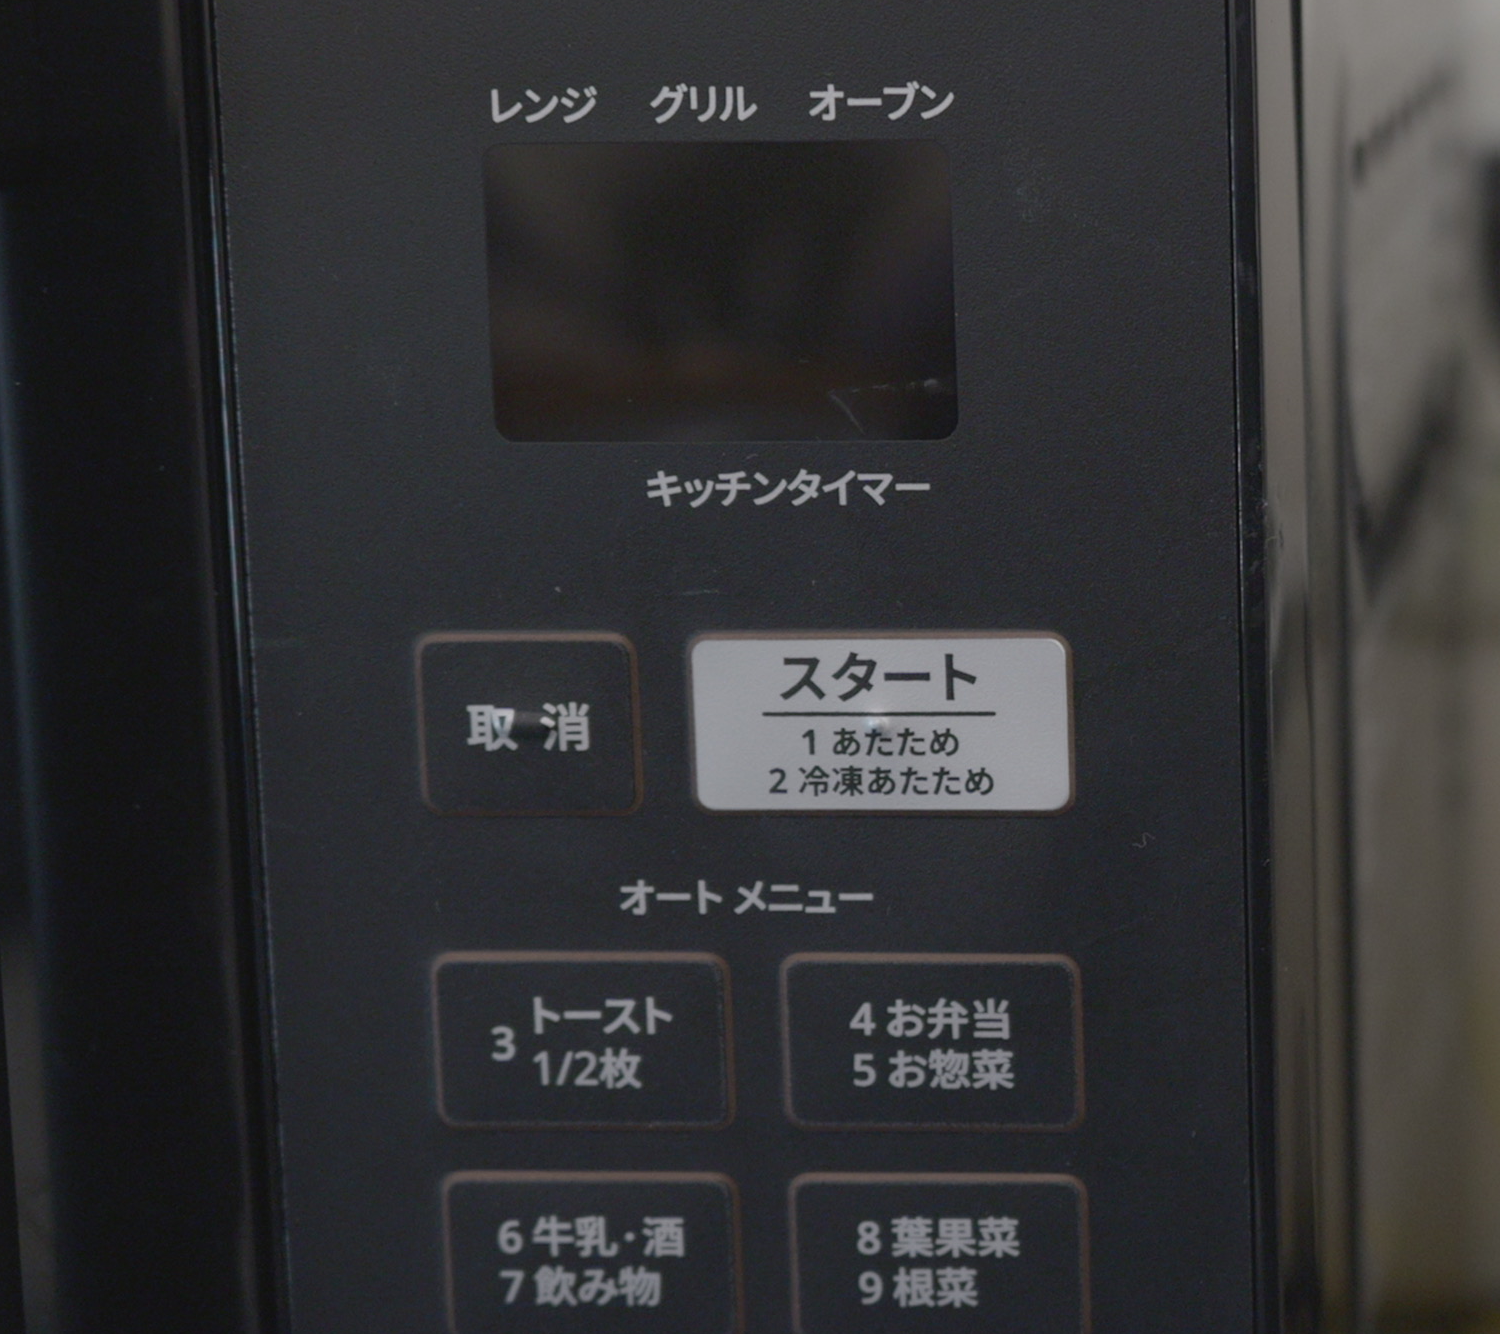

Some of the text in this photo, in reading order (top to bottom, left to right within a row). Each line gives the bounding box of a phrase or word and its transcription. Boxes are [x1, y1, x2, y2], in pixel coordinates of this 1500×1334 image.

[489, 84, 599, 125] レンジ
[649, 82, 759, 125] グリル
[808, 79, 956, 123] オーブン
[645, 467, 932, 509] キッチンタイマー
[779, 650, 978, 703] スタート
[801, 726, 961, 758] 1 あたため
[767, 764, 996, 798] 2 冷凍あたため
[532, 995, 674, 1036] トースト
[848, 996, 1012, 1041] 4 お弁当
[490, 1024, 518, 1063] 3
[532, 1046, 643, 1090] 1/2枚
[852, 1047, 1016, 1092] 5 お惣菜
[496, 1218, 525, 1256] 6
[855, 1214, 1021, 1259] 8 葉果菜
[498, 1263, 663, 1308] 7 飲み物
[857, 1265, 979, 1309] 9 根菜
